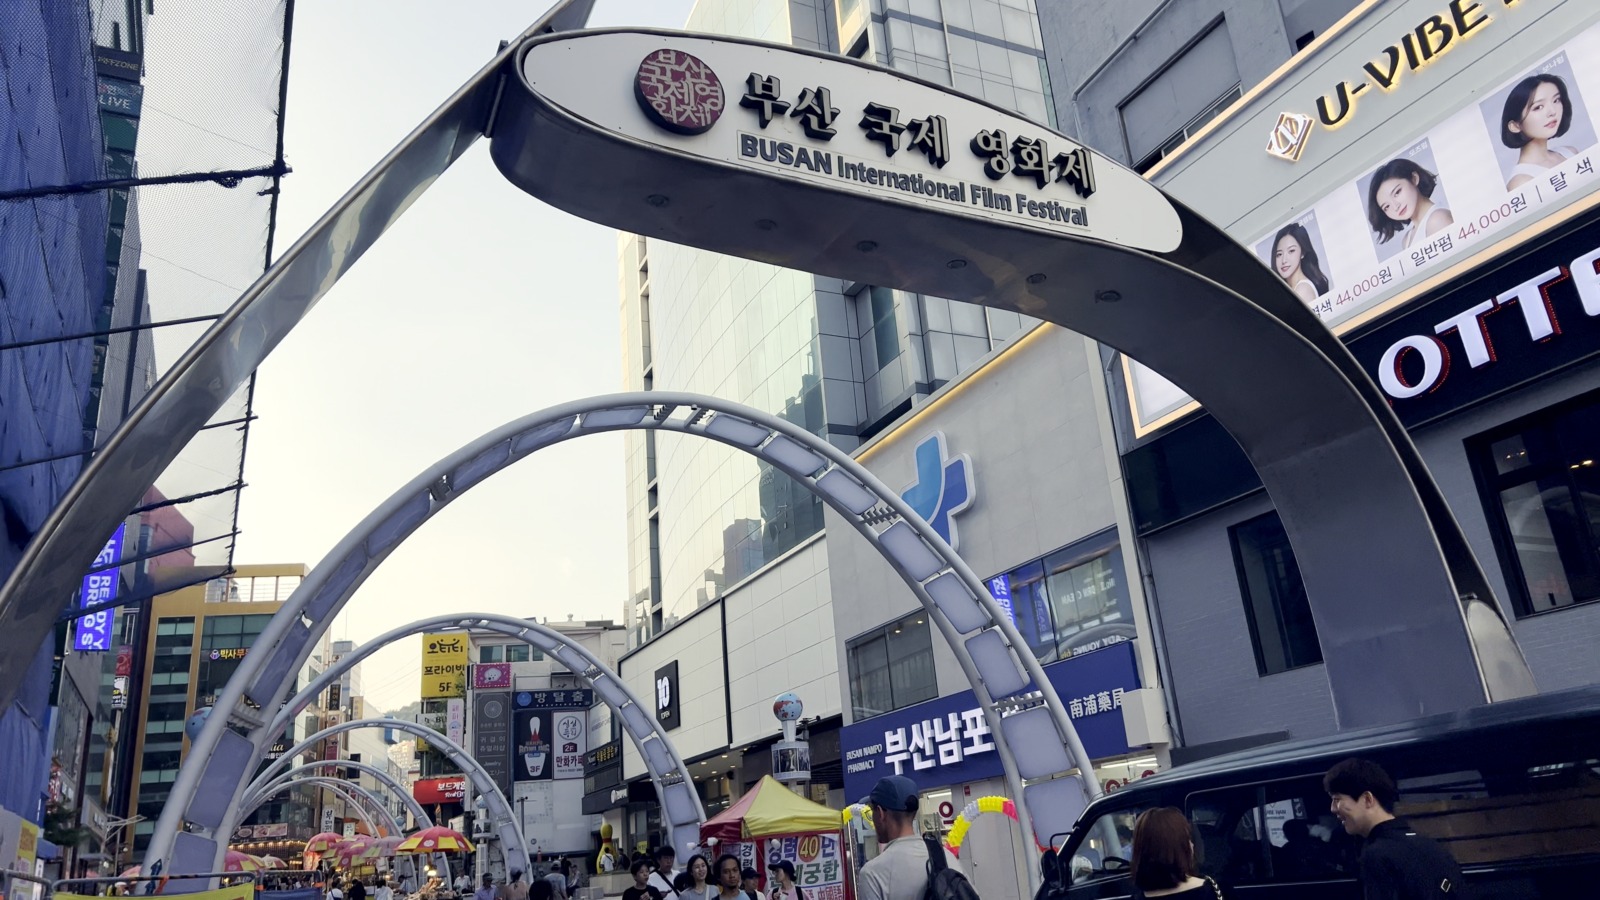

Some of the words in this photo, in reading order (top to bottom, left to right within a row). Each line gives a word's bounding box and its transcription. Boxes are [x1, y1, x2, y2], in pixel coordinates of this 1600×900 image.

[1316, 0, 1489, 126] U-VIBE
[739, 72, 841, 142] 부산
[858, 102, 950, 170] 국제
[970, 129, 1097, 199] 영화제
[740, 133, 833, 175] BUSAN
[837, 155, 966, 202] International
[970, 184, 1012, 212] Film
[1016, 192, 1089, 227] Festival
[1335, 266, 1393, 306] 44,000원
[1411, 233, 1453, 267] 일반펌
[1458, 193, 1527, 240] 44,000원
[94, 575, 112, 634] REDY
[424, 664, 465, 677] 프라이빗
[438, 682, 452, 693] 5F
[564, 744, 574, 752] 2F
[846, 749, 863, 761] BUSAN
[863, 743, 883, 756] NAMPO
[530, 765, 541, 773] 3F
[847, 759, 875, 774] PHARMACY
